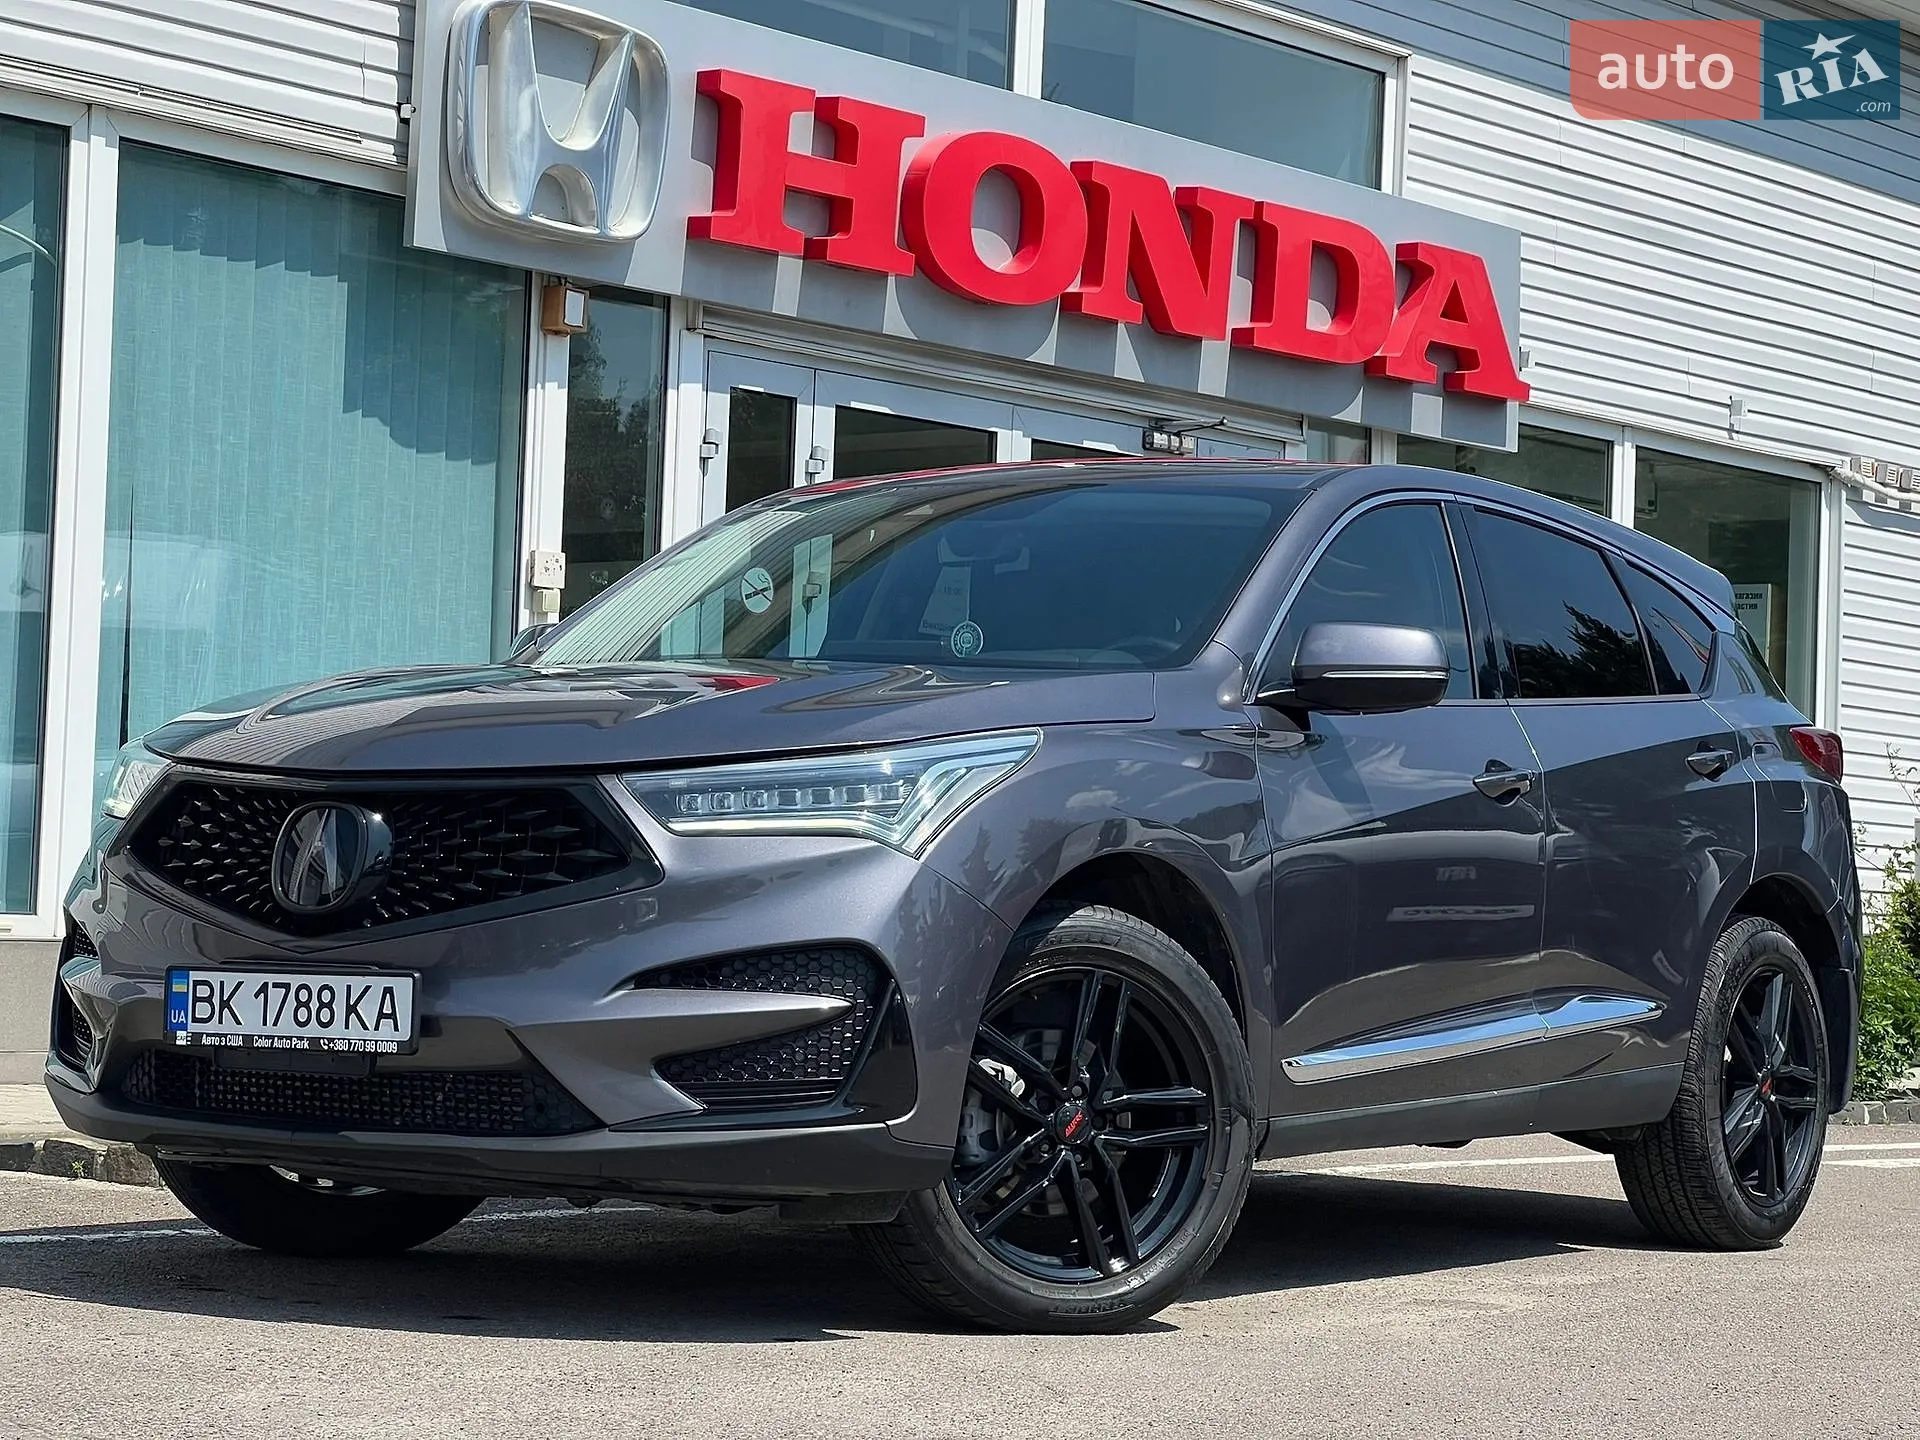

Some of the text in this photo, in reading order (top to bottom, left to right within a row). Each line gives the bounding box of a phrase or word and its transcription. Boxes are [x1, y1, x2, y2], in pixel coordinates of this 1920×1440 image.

[686, 67, 1531, 403] HONDA
[190, 979, 400, 1033] BK 1788 KA
[170, 1009, 187, 1025] UA
[201, 1033, 220, 1046] Авто
[226, 1034, 243, 1047] США
[253, 1036, 310, 1050] Color Auto Park
[328, 1039, 398, 1053] +380 770 99 0009
